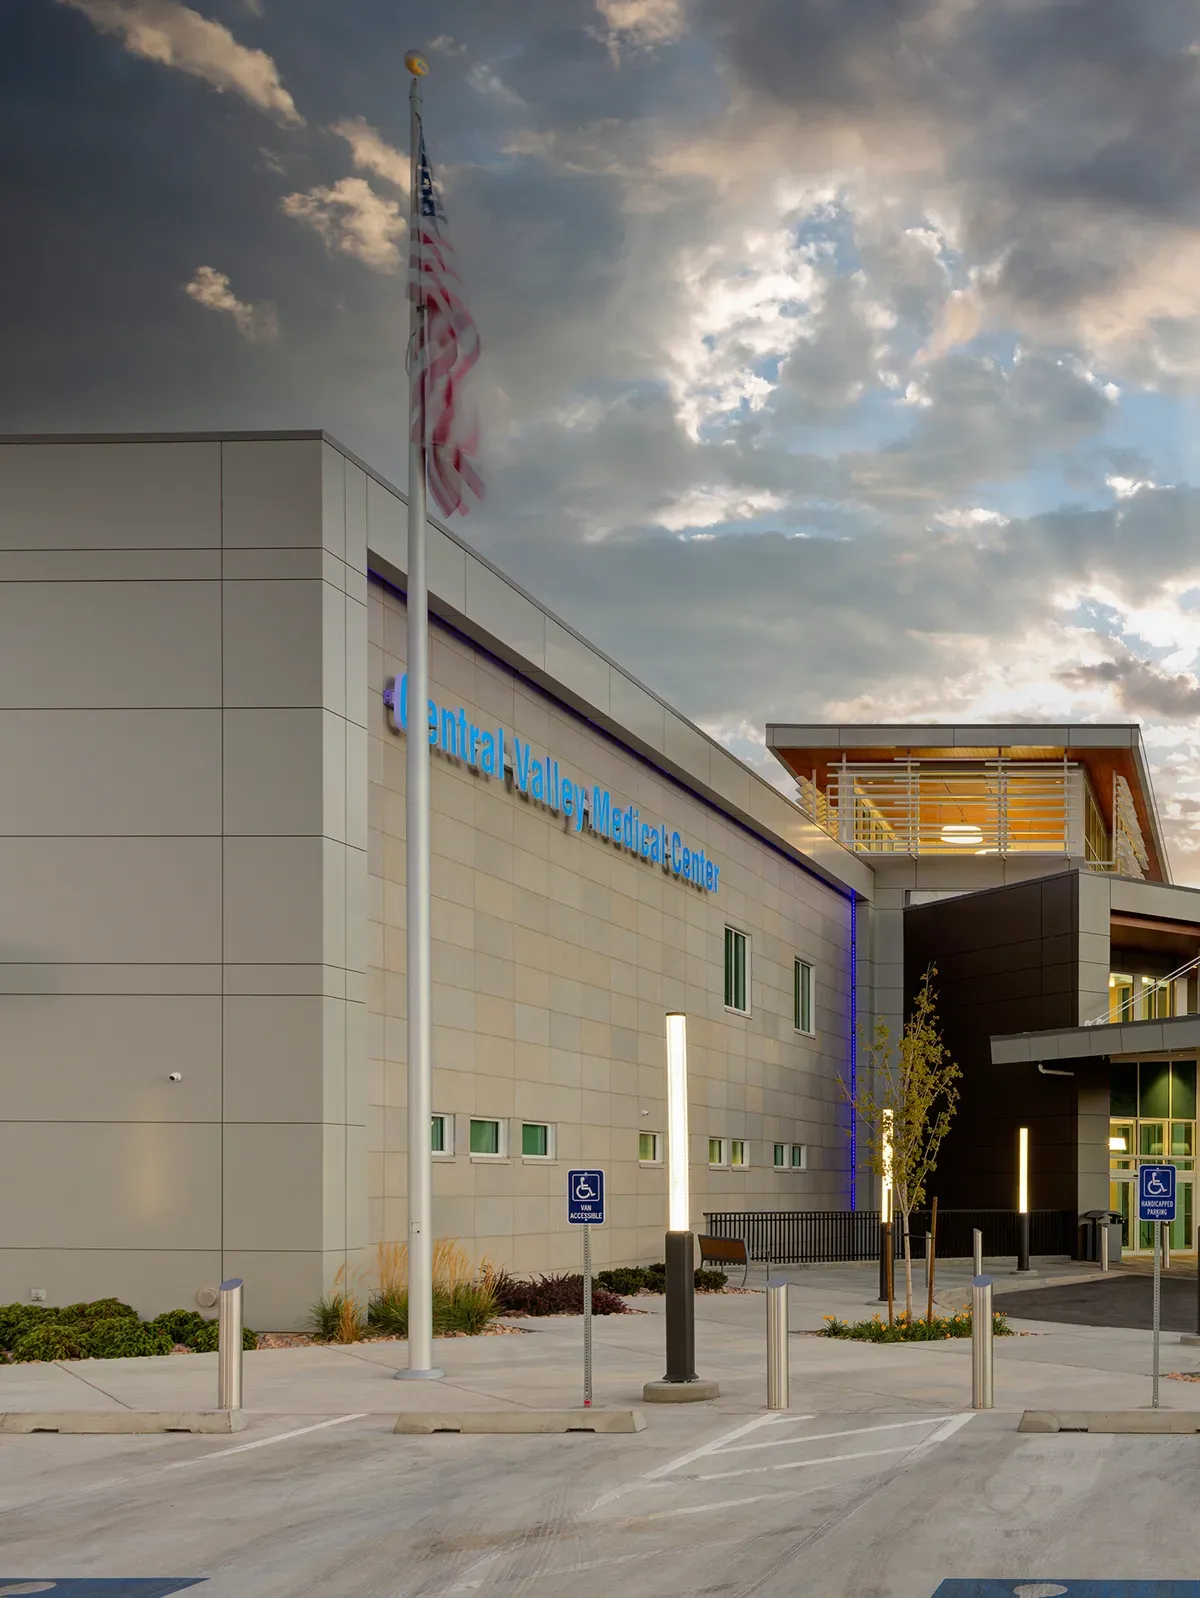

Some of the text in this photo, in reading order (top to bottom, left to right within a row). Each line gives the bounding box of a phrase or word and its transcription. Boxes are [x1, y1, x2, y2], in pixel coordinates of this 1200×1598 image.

[513, 737, 587, 832] Valley
[591, 785, 666, 865] Medical
[671, 831, 721, 893] Center
